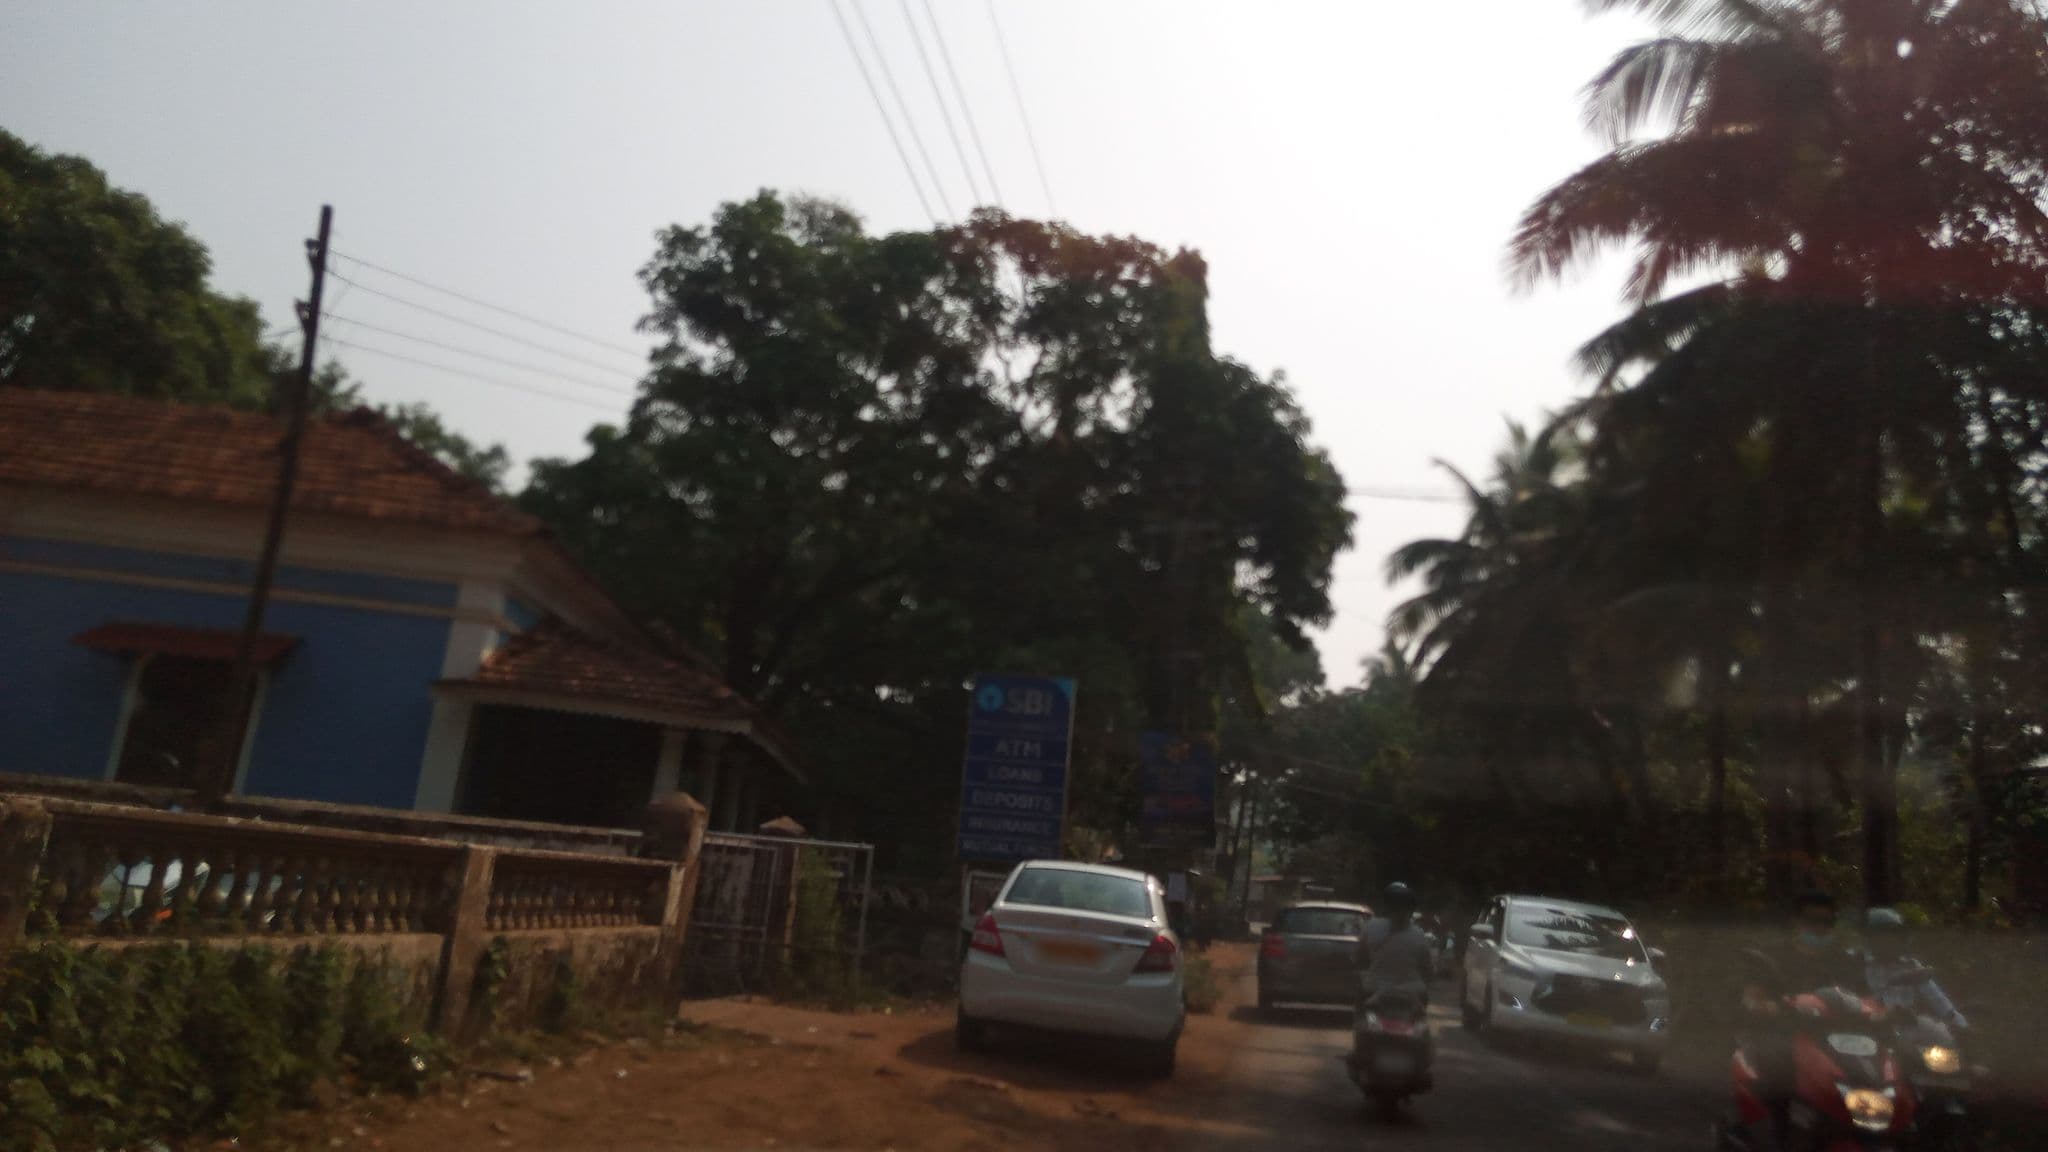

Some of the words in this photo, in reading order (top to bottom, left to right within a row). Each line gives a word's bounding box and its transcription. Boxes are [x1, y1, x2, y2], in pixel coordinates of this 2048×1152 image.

[1006, 688, 1053, 714] SBI
[995, 738, 1041, 757] ATM
[972, 791, 1055, 810] DEPOSITS
